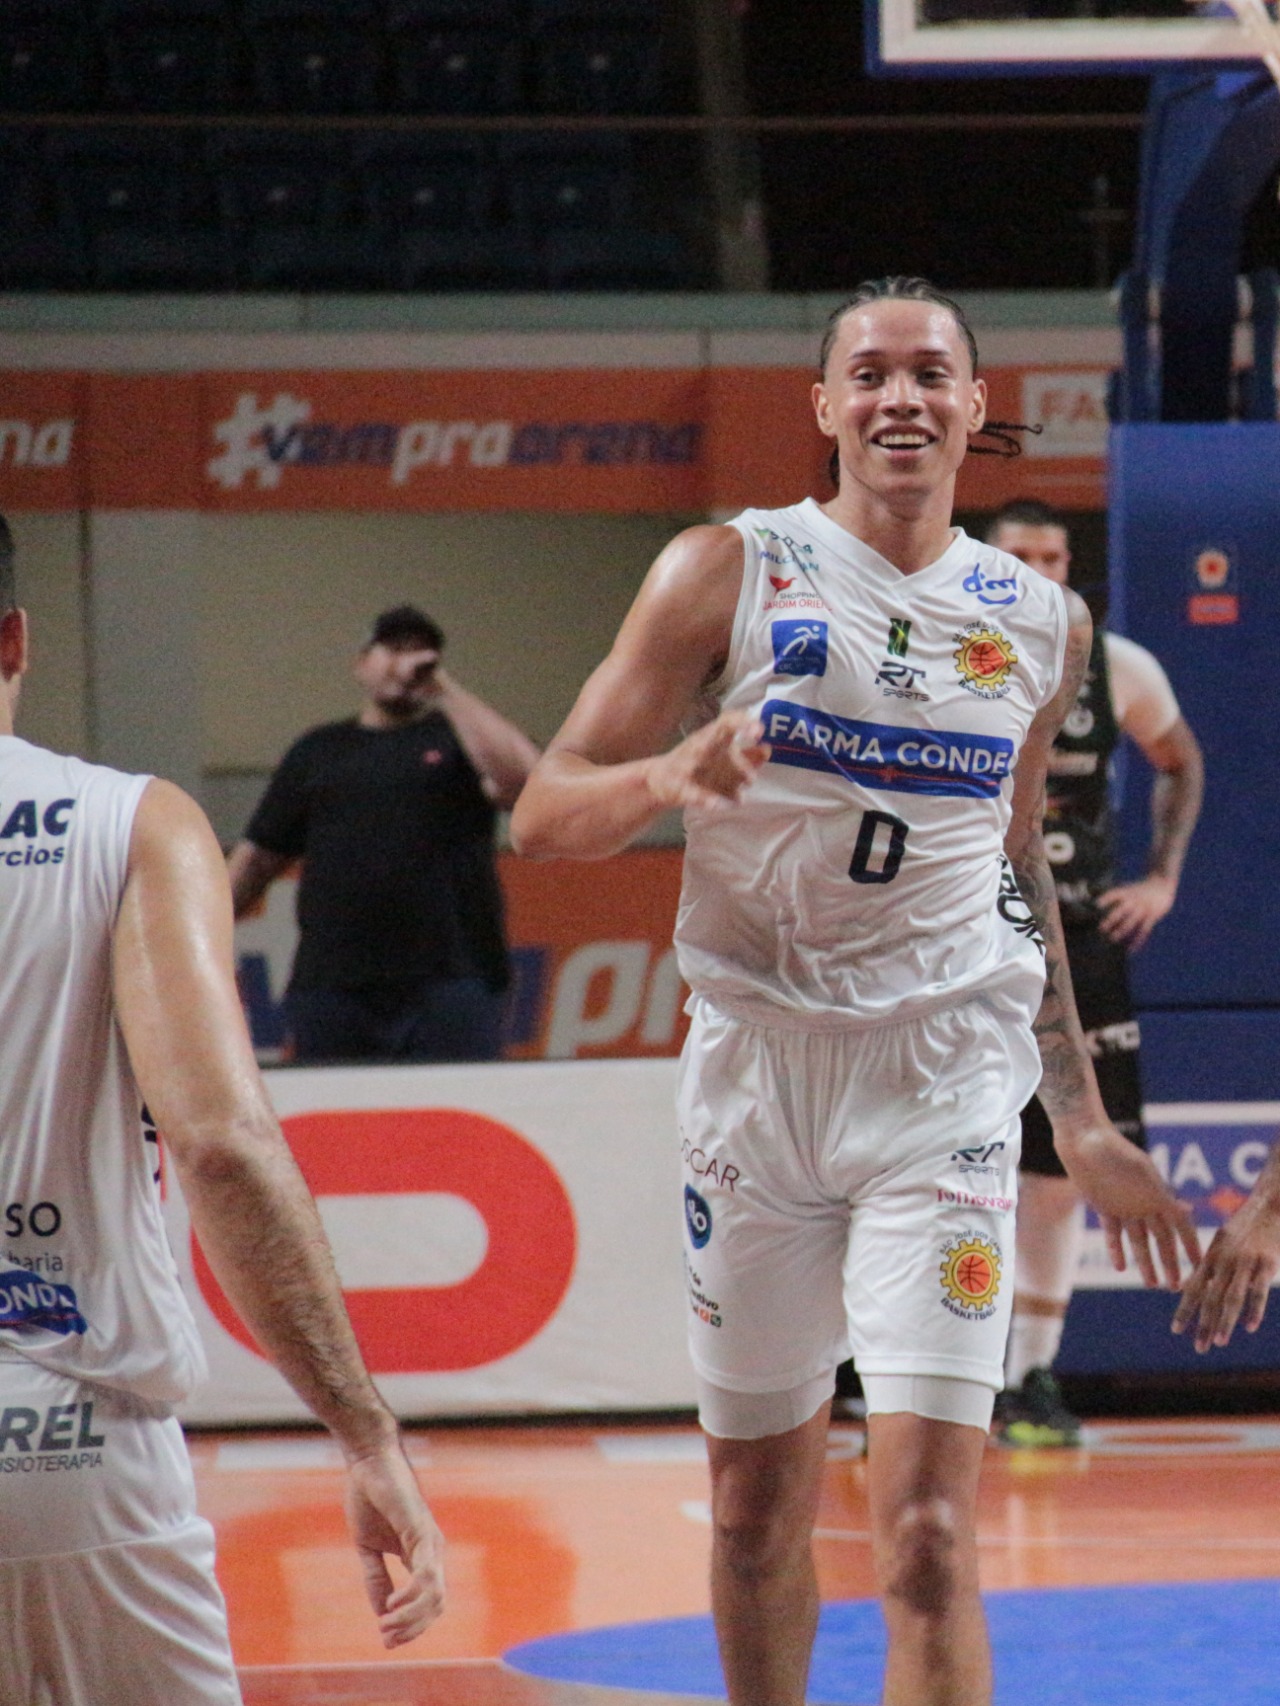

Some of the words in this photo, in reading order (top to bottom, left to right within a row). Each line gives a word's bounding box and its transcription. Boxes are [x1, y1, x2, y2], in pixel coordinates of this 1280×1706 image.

[763, 600, 797, 611] JARDIM
[883, 688, 930, 702] SPORTS
[769, 713, 885, 763] FARMA
[897, 741, 1009, 775] CONDE
[848, 810, 909, 884] 0
[680, 1126, 740, 1192] SCAR
[958, 1163, 1000, 1177] SPORTS
[940, 1296, 997, 1321] BASKETBALL
[0, 1401, 105, 1452] REL
